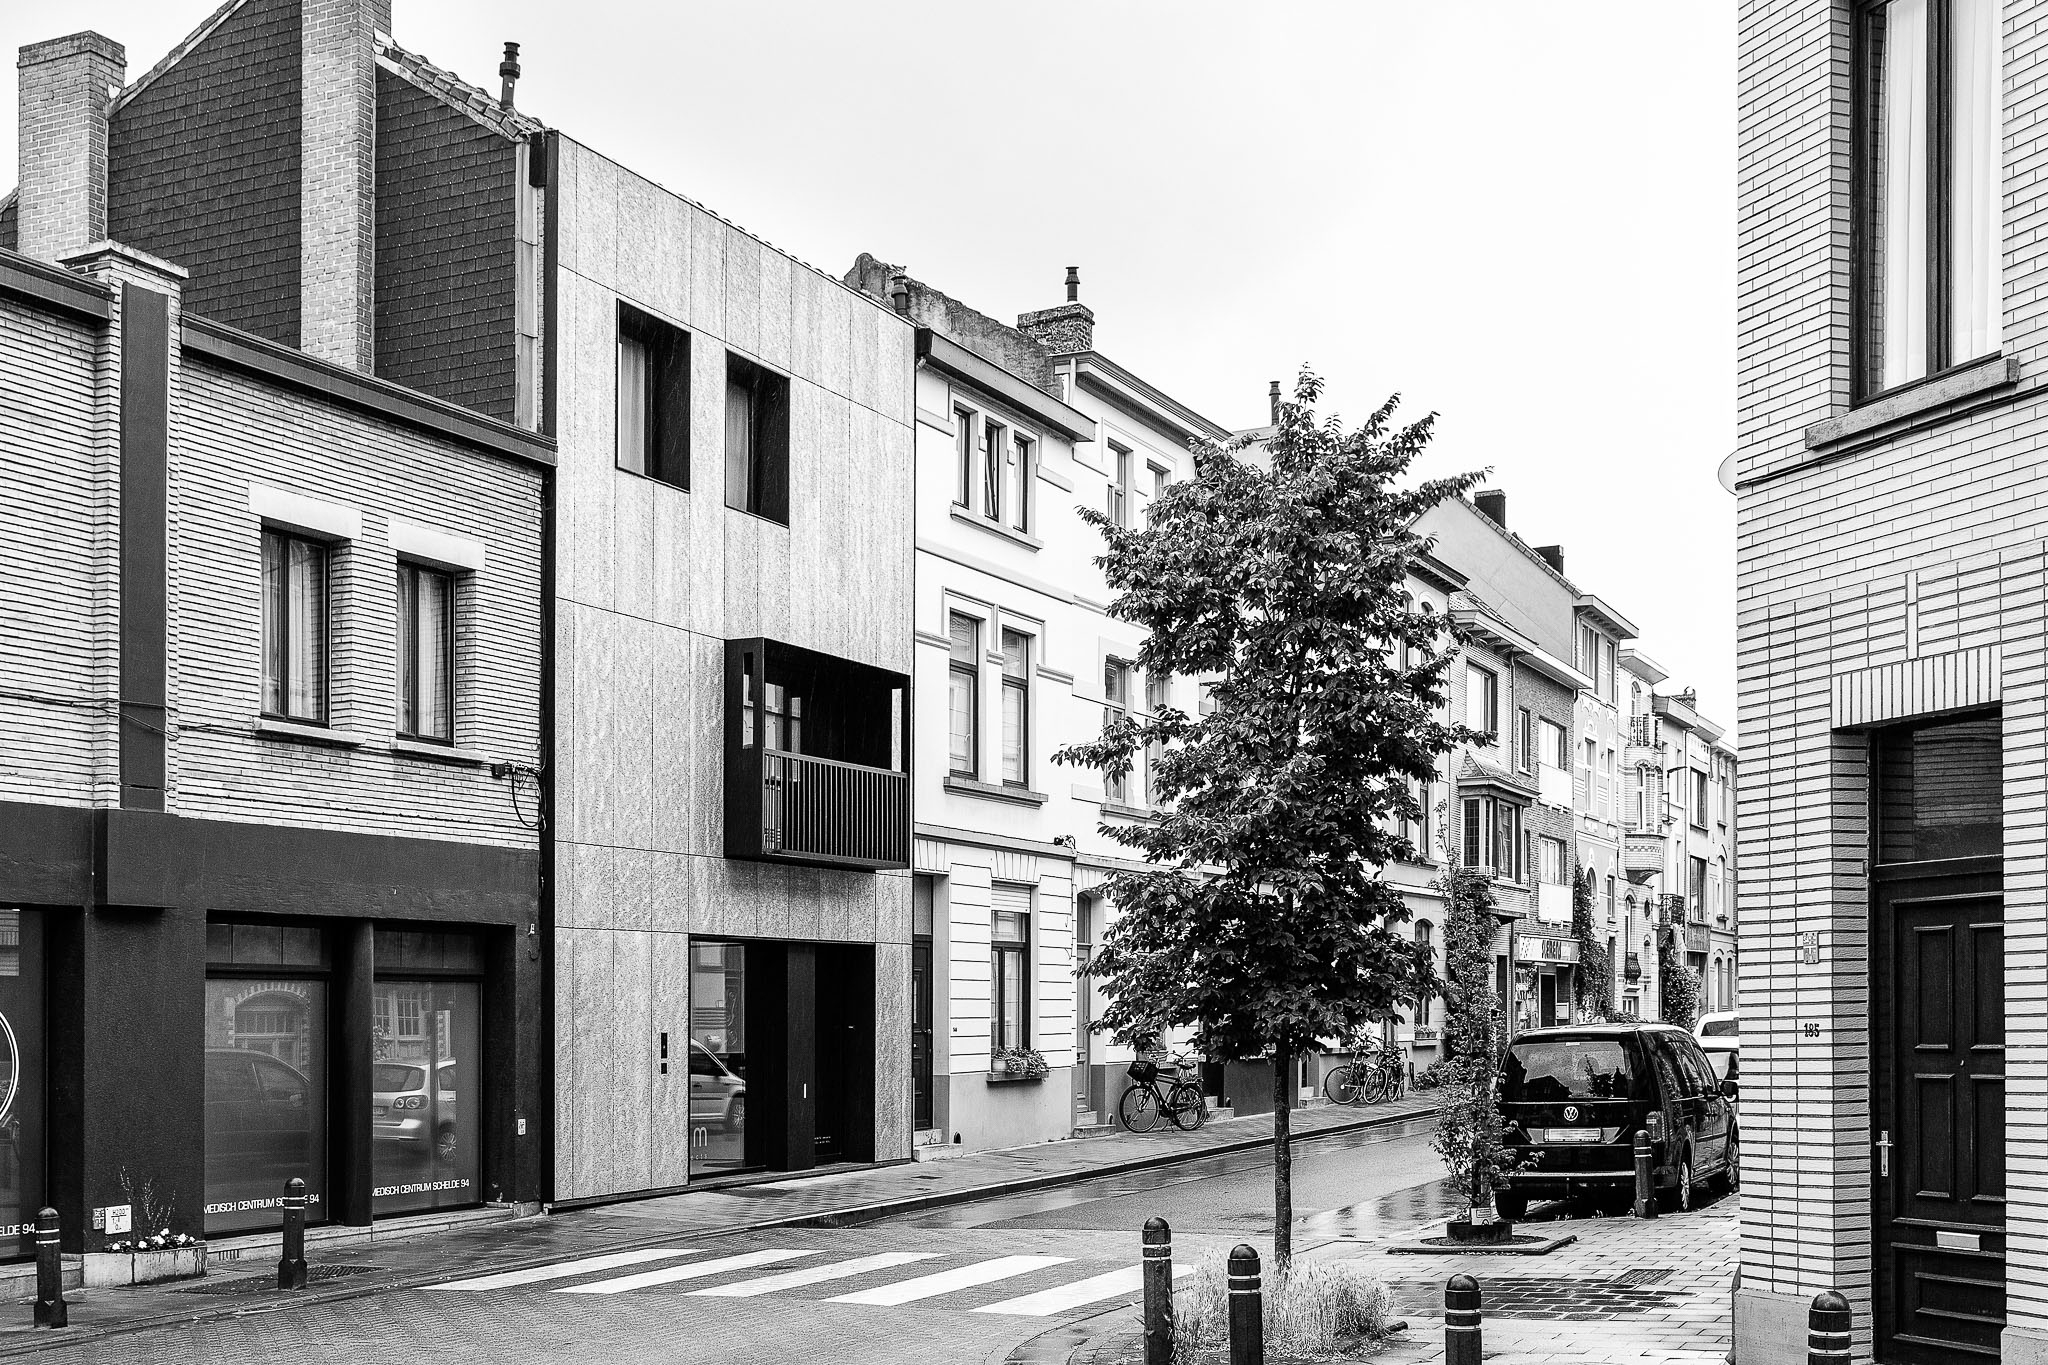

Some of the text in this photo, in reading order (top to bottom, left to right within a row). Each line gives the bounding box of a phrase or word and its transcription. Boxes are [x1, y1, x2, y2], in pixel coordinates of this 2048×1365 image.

[1803, 1023, 1820, 1038] 185
[400, 1182, 432, 1194] CENTRUM
[432, 1179, 460, 1191] SCHELDE
[460, 1178, 470, 1188] 94
[237, 1197, 275, 1211] CENTRUM
[309, 1193, 320, 1204] 94
[22, 1223, 36, 1235] 94
